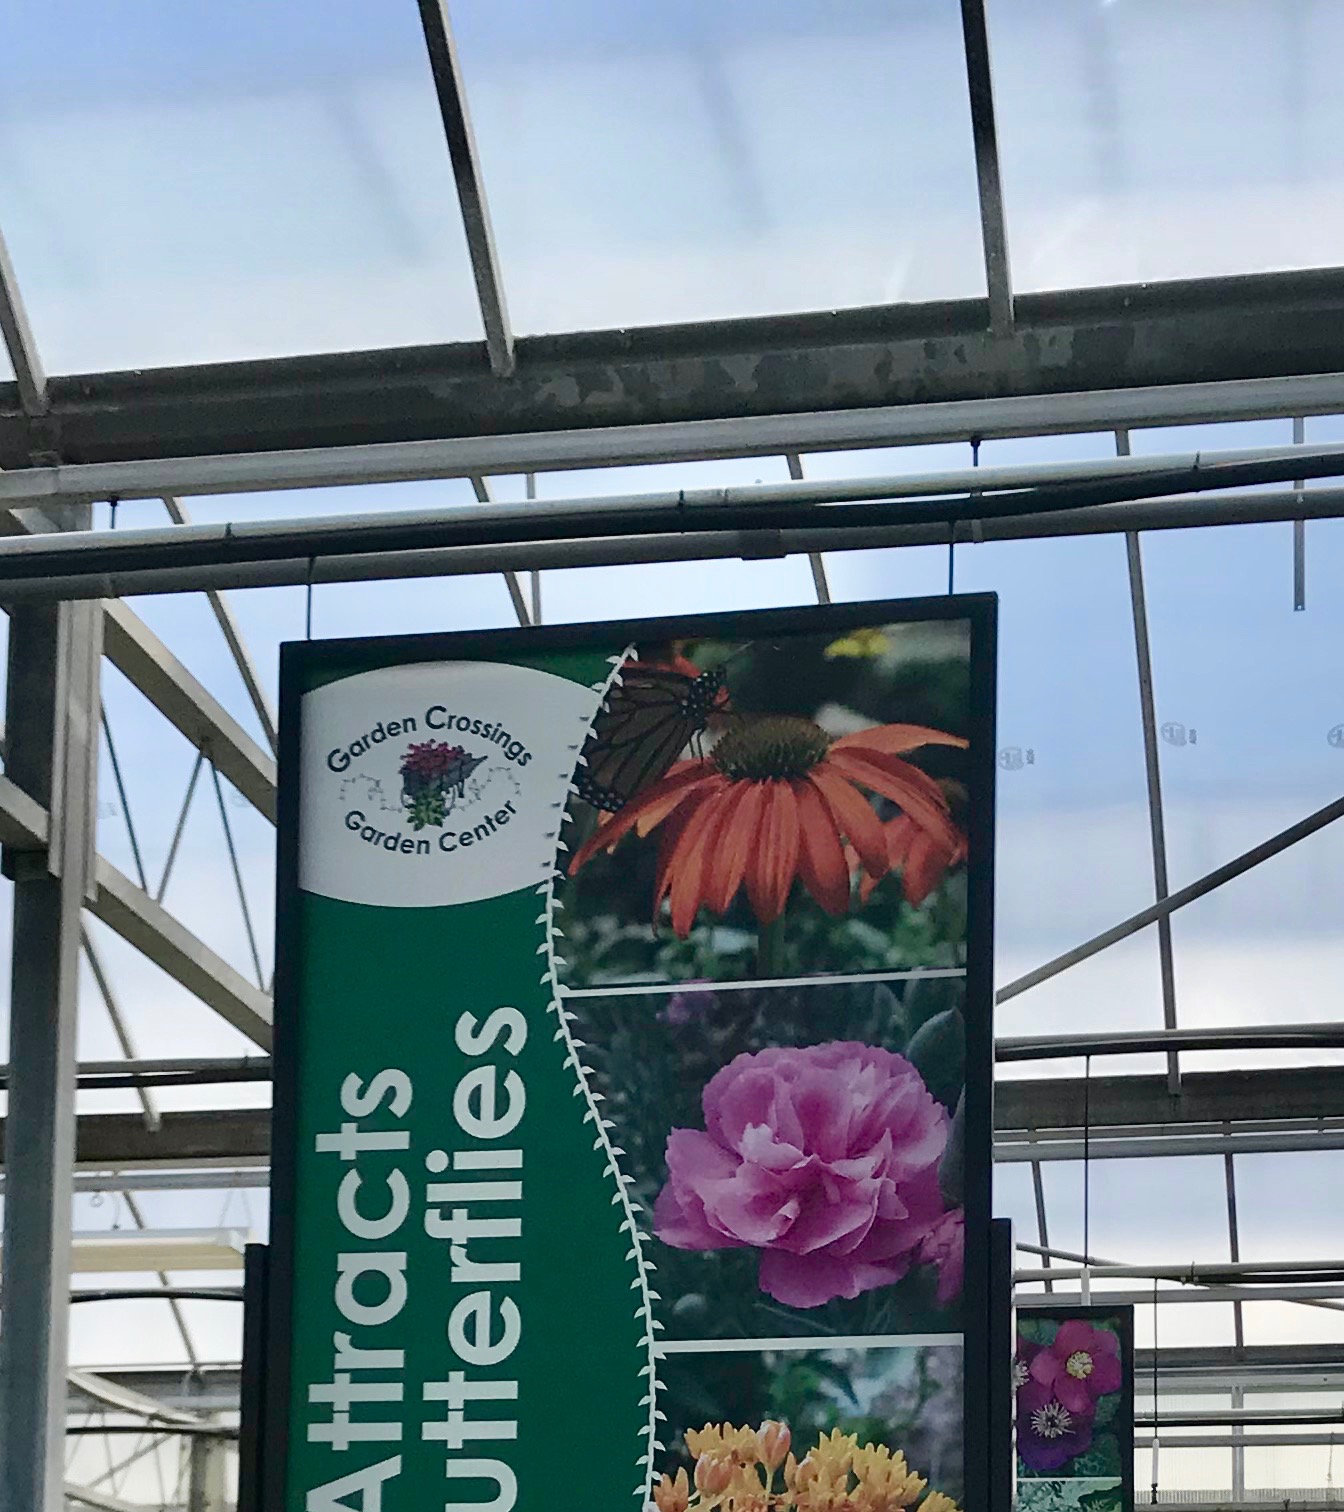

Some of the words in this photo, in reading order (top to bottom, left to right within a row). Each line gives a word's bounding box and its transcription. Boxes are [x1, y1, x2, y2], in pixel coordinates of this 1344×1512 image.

[327, 716, 417, 773] Garden
[425, 705, 533, 767] Crossings
[344, 810, 430, 854] Garden
[438, 800, 517, 852] Center
